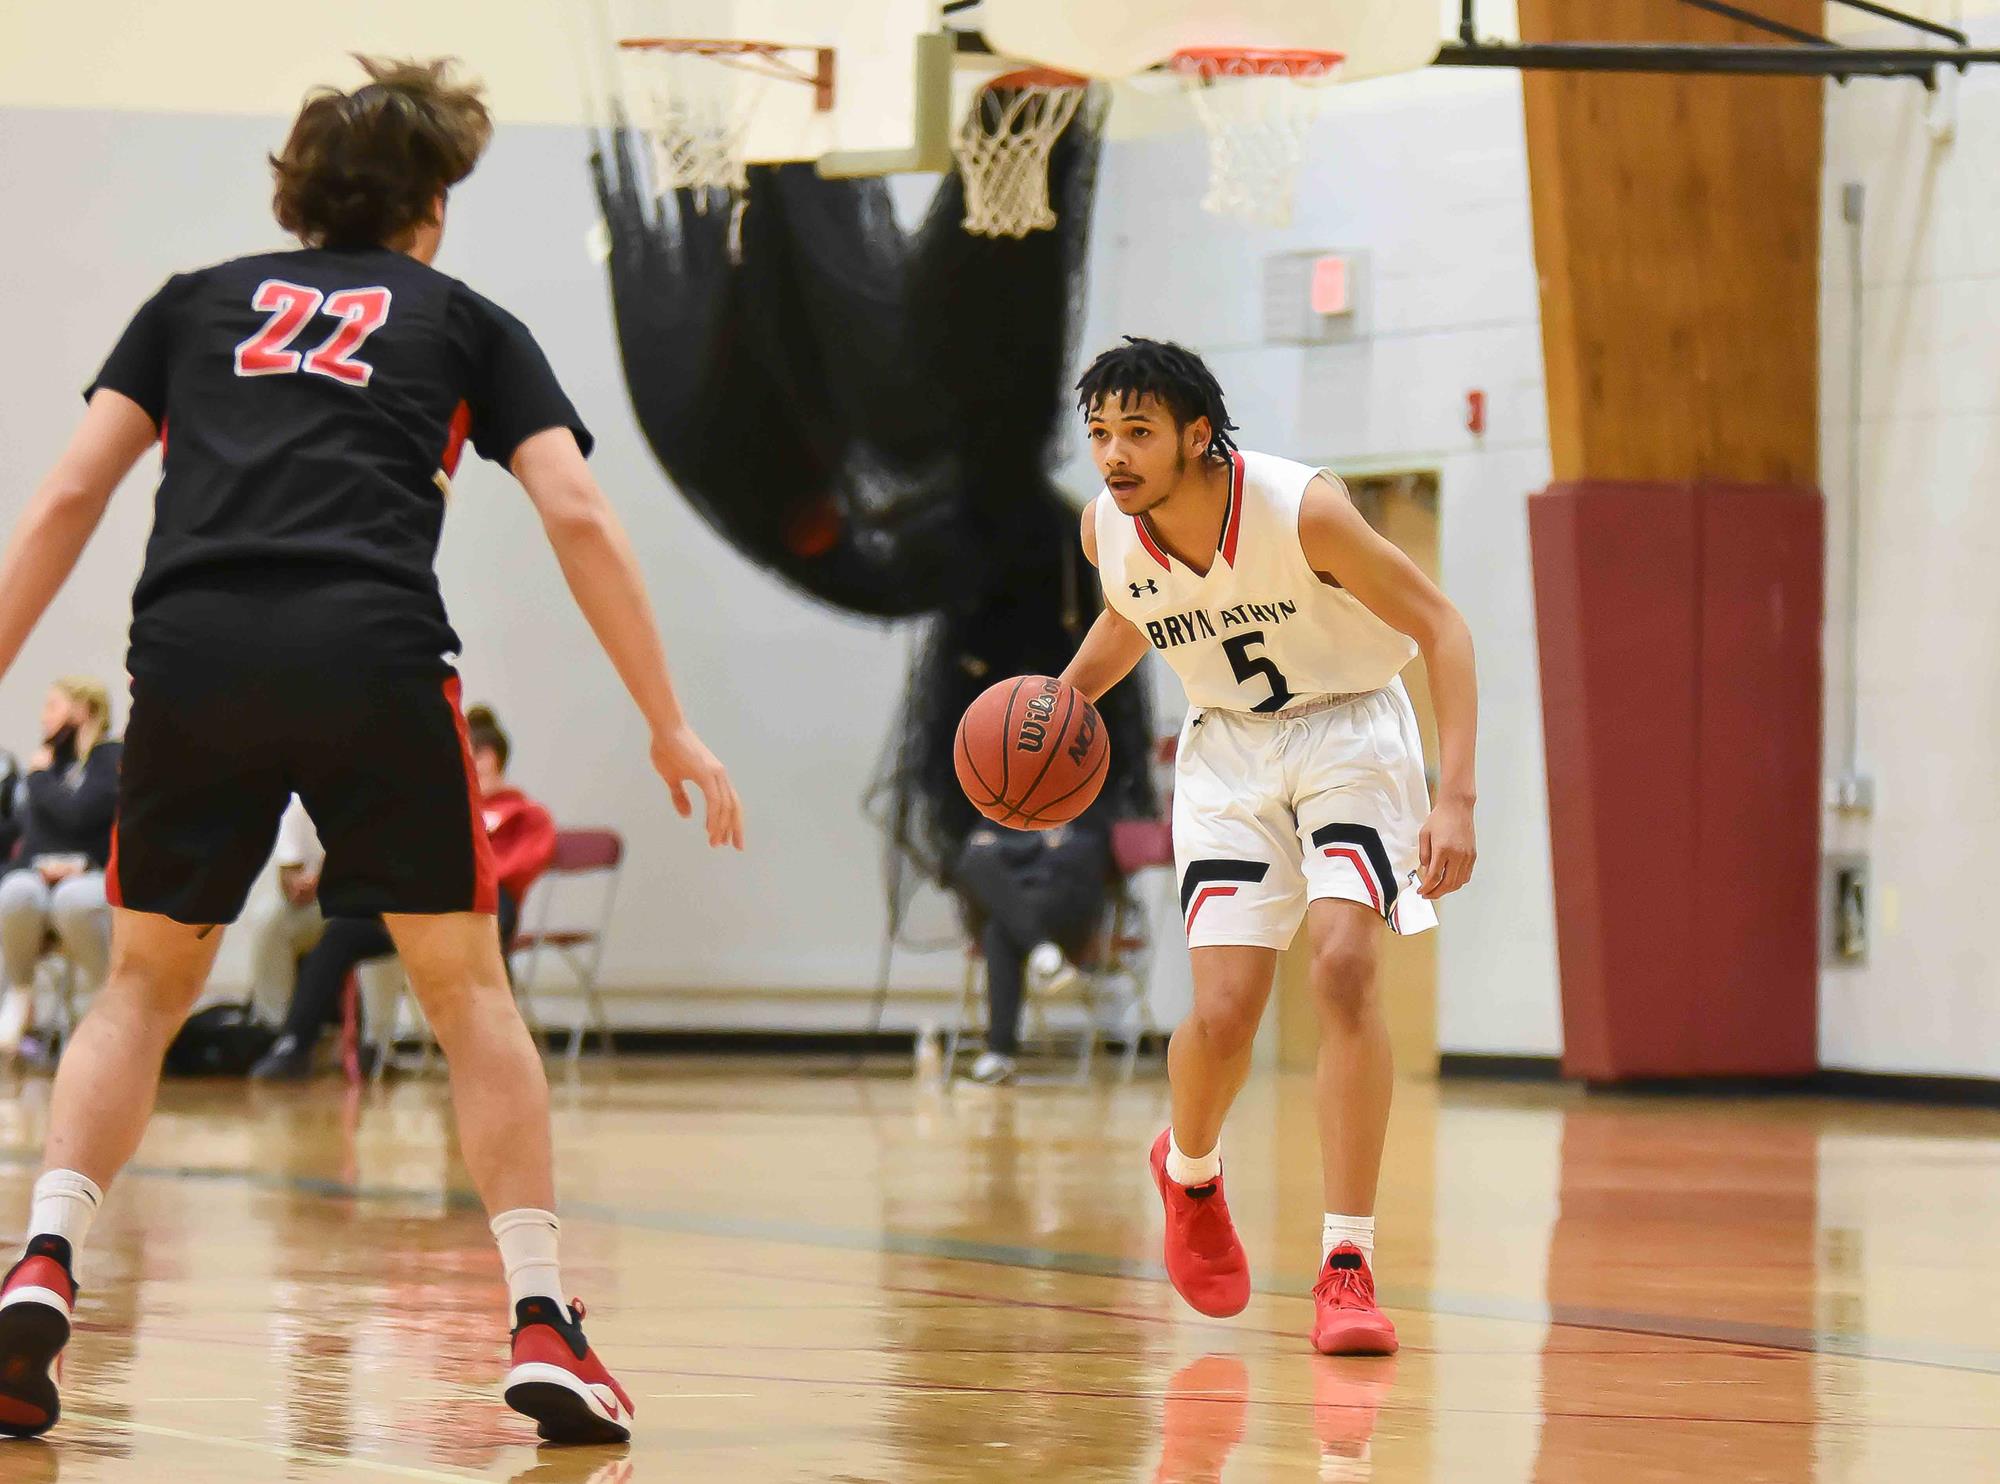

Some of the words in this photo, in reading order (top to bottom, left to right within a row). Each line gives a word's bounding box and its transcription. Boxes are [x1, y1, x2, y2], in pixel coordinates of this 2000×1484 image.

[234, 279, 392, 388] 22
[1146, 609, 1217, 651] BRYN
[1220, 599, 1297, 628] ATHYN
[1222, 631, 1295, 714] 5
